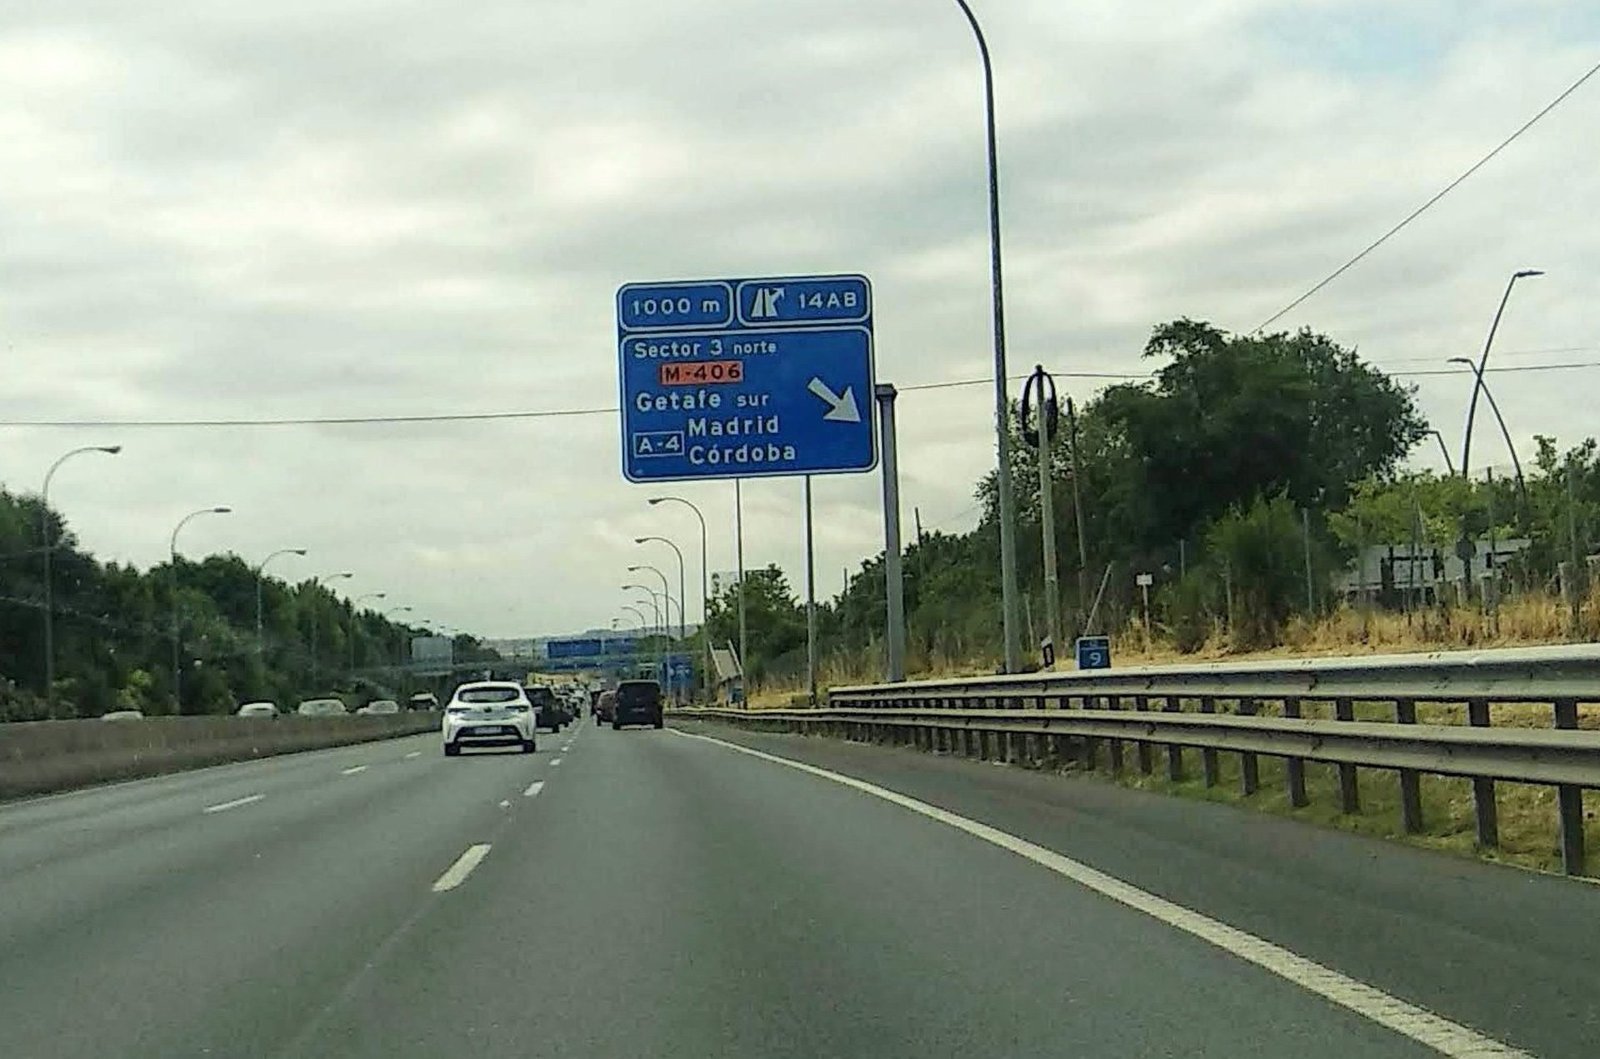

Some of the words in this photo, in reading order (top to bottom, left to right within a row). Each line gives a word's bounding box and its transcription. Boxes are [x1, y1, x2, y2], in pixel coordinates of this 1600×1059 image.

[632, 299, 690, 316] 1000
[702, 299, 720, 313] m
[799, 292, 857, 309] 14AB
[634, 341, 700, 358] Sector
[710, 340, 723, 355] 3
[733, 341, 777, 355] norte
[664, 363, 741, 381] M-406
[636, 390, 721, 412] Getafe
[737, 393, 769, 407] sur
[688, 415, 779, 438] Madrid
[638, 436, 680, 453] A-4
[689, 443, 796, 465] Córdoba
[1090, 652, 1101, 666] 9
